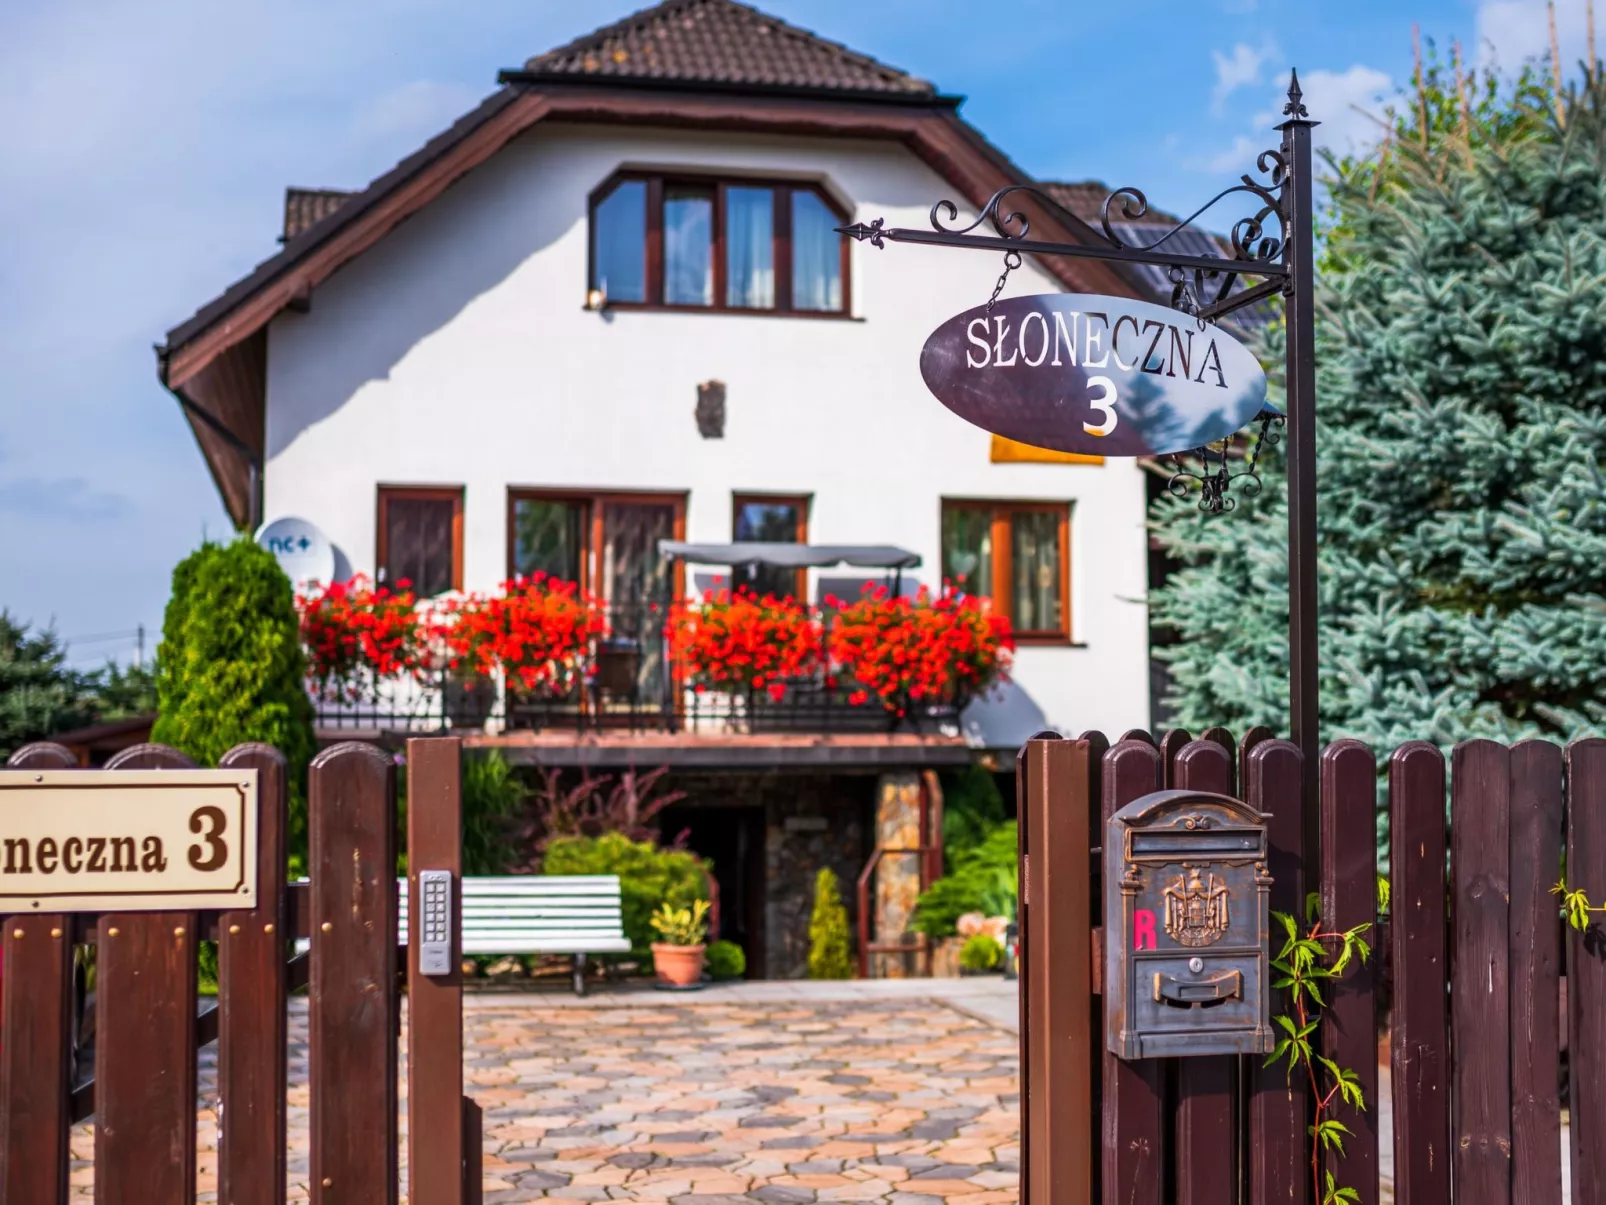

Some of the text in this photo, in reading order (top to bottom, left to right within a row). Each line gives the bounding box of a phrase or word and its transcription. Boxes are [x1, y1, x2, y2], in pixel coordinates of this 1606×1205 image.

[966, 311, 1229, 389] SŁONECZNA
[1083, 375, 1118, 437] 3
[0, 805, 228, 875] neczna 3
[1134, 908, 1157, 951] R
